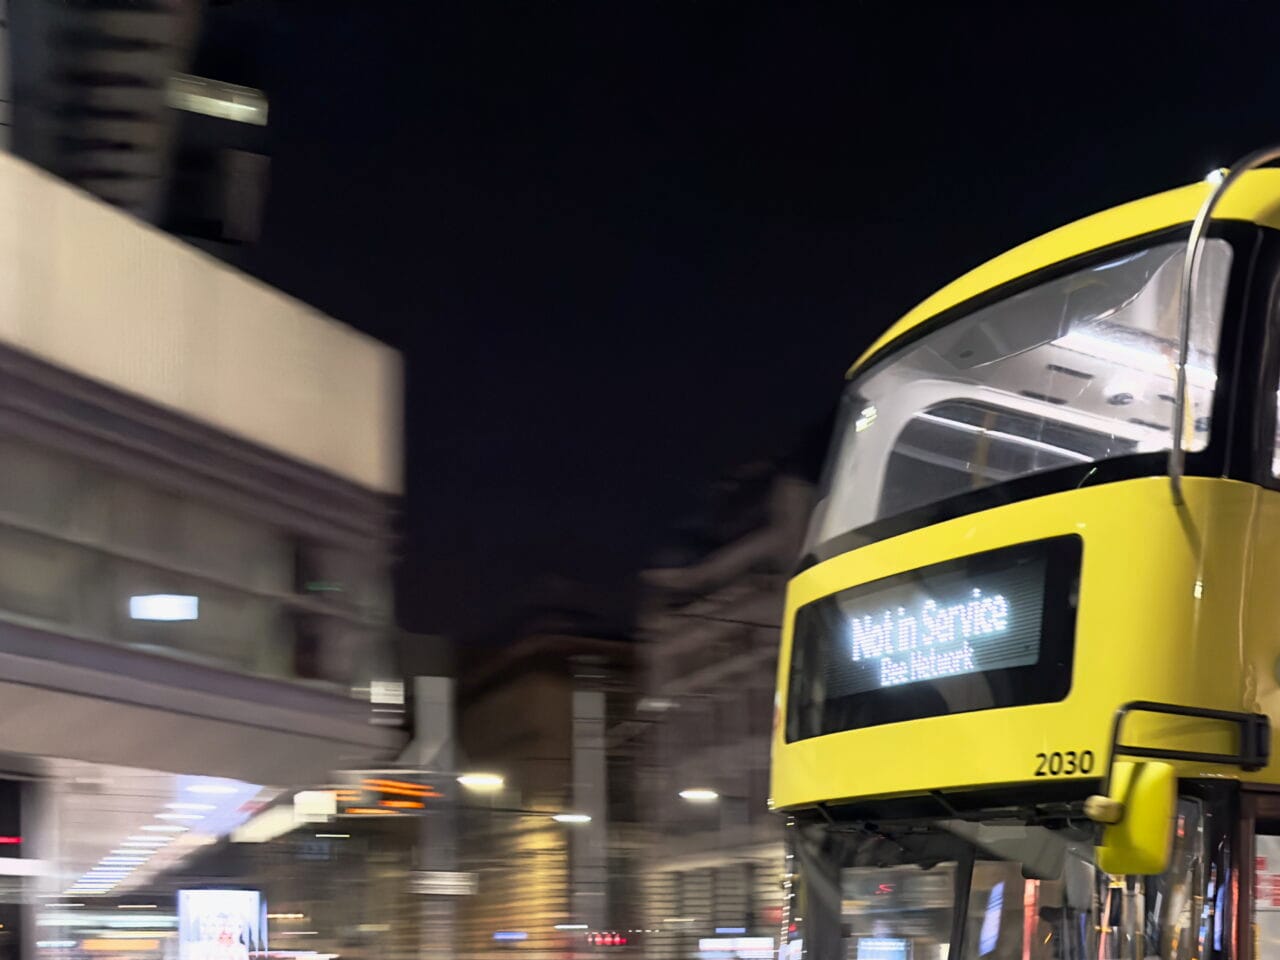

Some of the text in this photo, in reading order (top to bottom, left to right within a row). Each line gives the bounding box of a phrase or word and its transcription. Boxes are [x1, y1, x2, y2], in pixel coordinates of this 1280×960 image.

[852, 588, 1008, 661] Not in Service
[910, 640, 974, 680] Network
[1034, 750, 1095, 777] 2030
